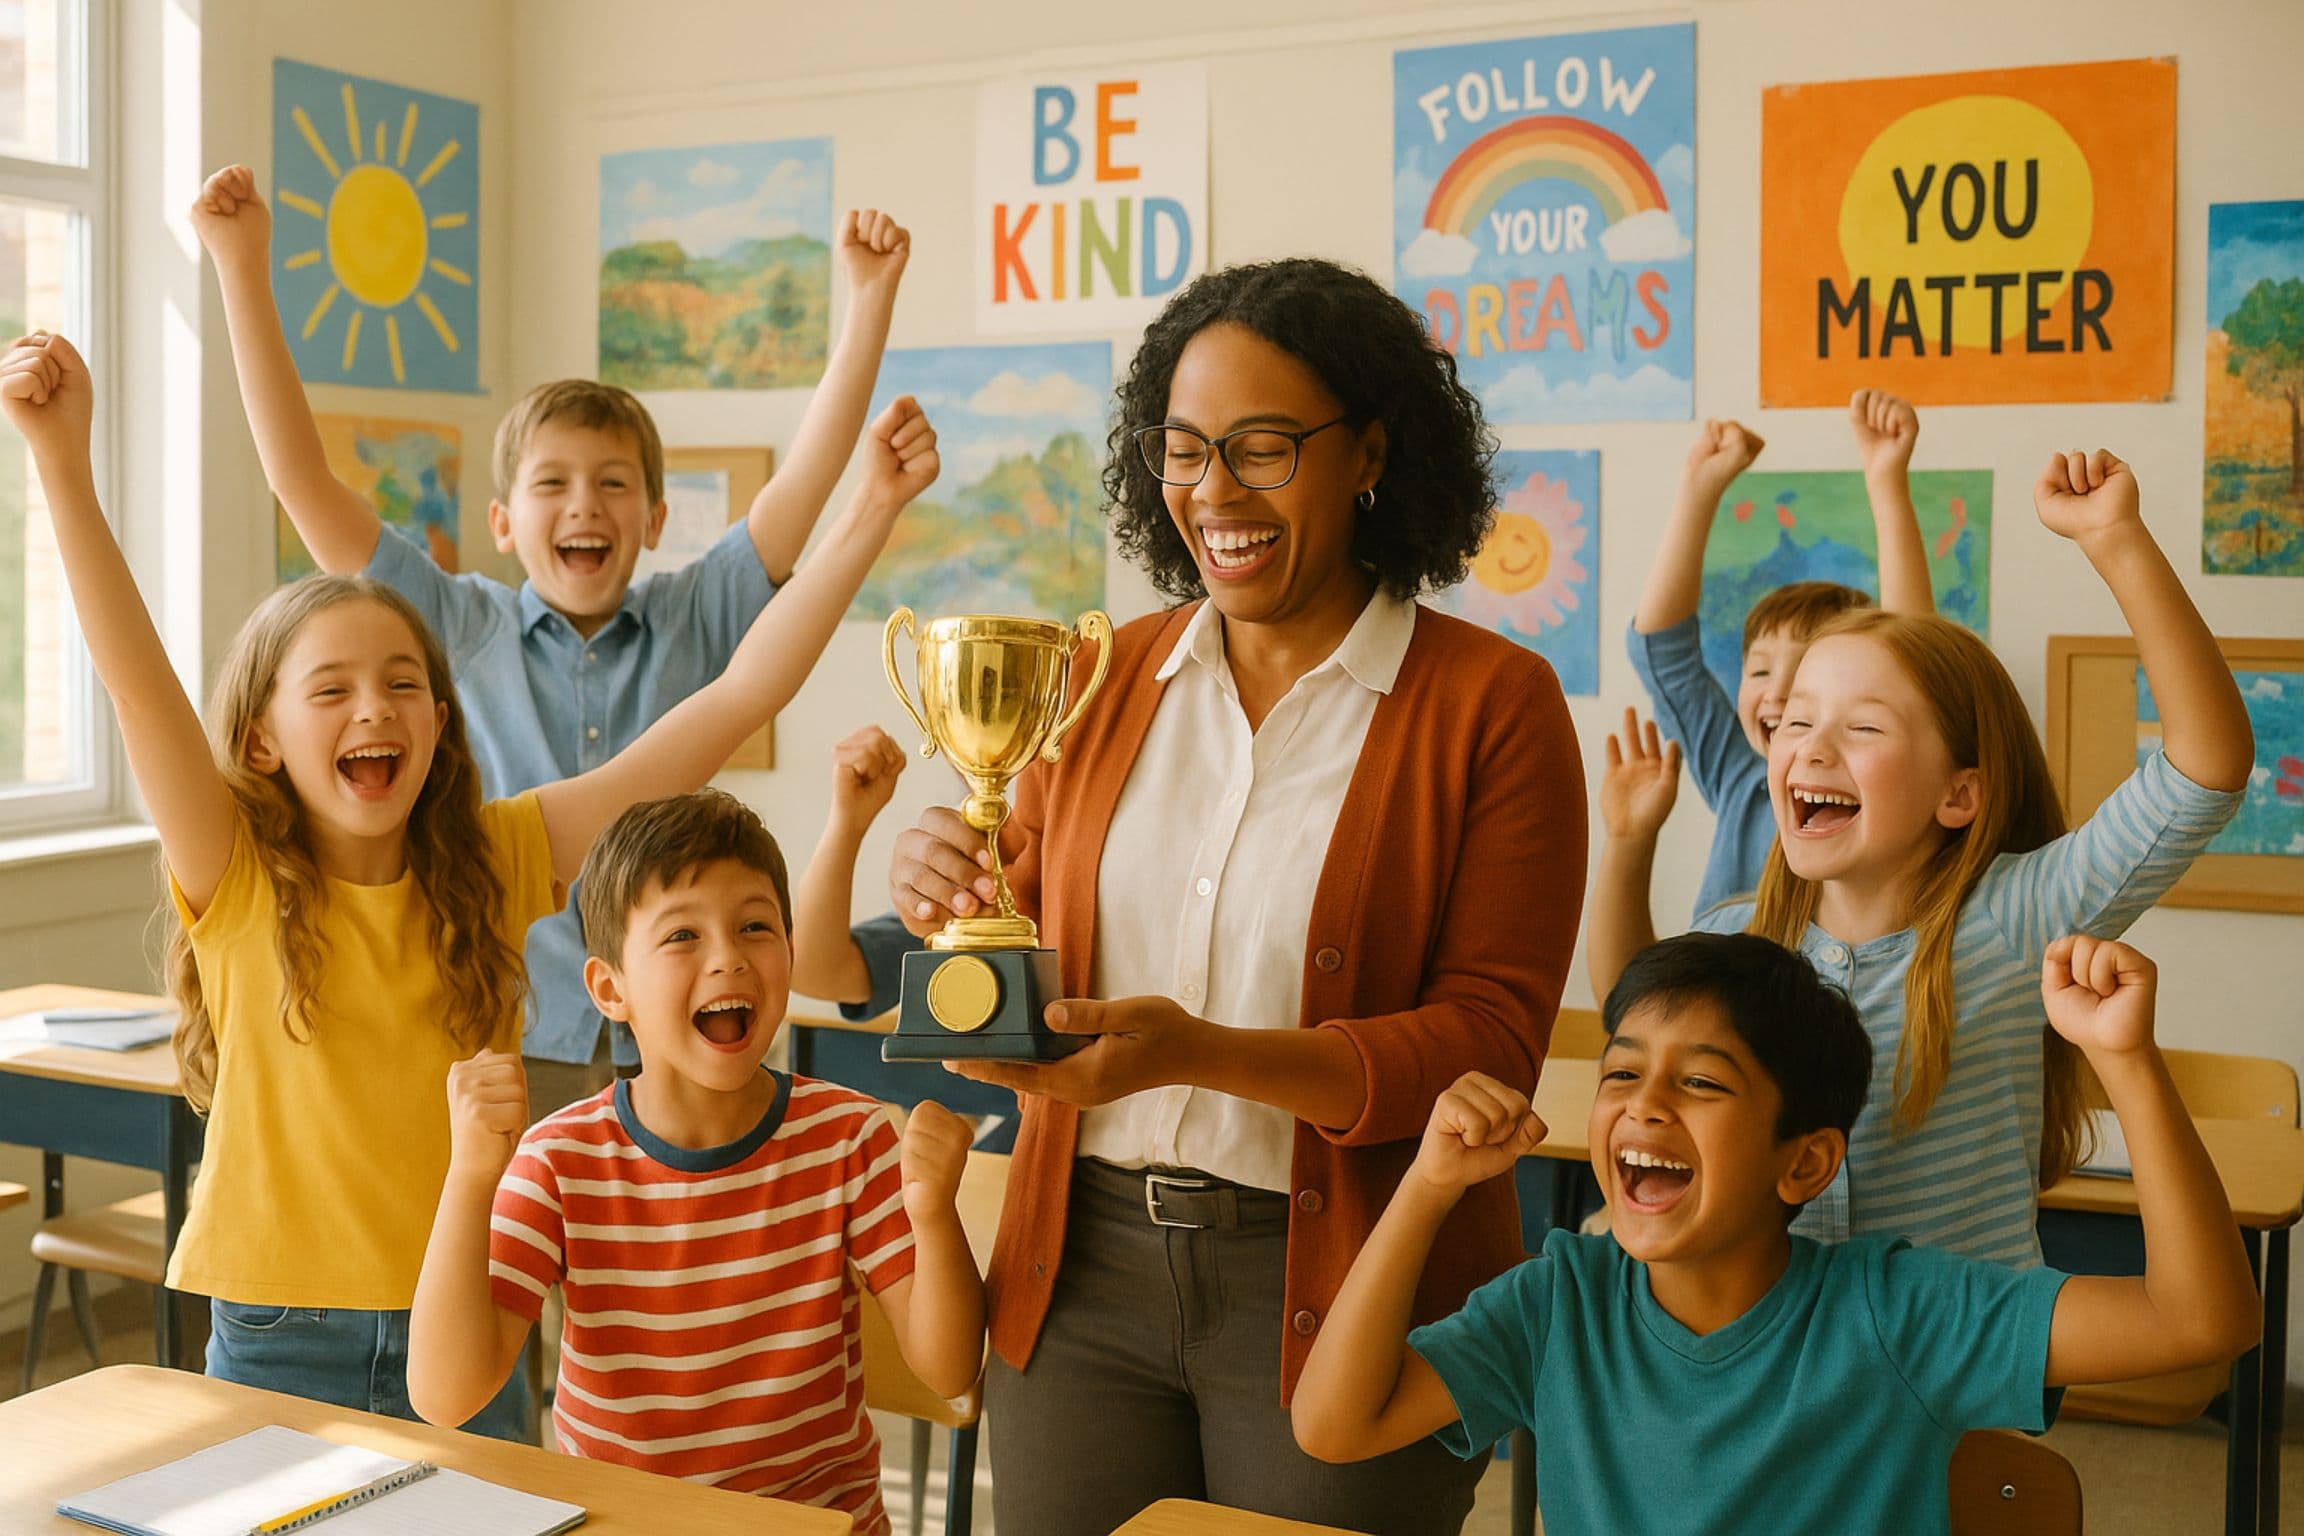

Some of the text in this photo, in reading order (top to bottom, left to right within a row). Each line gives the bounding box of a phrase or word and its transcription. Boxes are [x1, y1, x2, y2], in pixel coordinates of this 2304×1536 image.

[1034, 81, 1141, 186] BE
[1418, 56, 1657, 144] FOLLOW
[1491, 204, 1590, 255] YOUR
[1892, 159, 2038, 244] YOU
[993, 197, 1192, 303] KIND
[1425, 267, 1671, 363] DREAMS
[1817, 268, 2114, 359] MATTER
